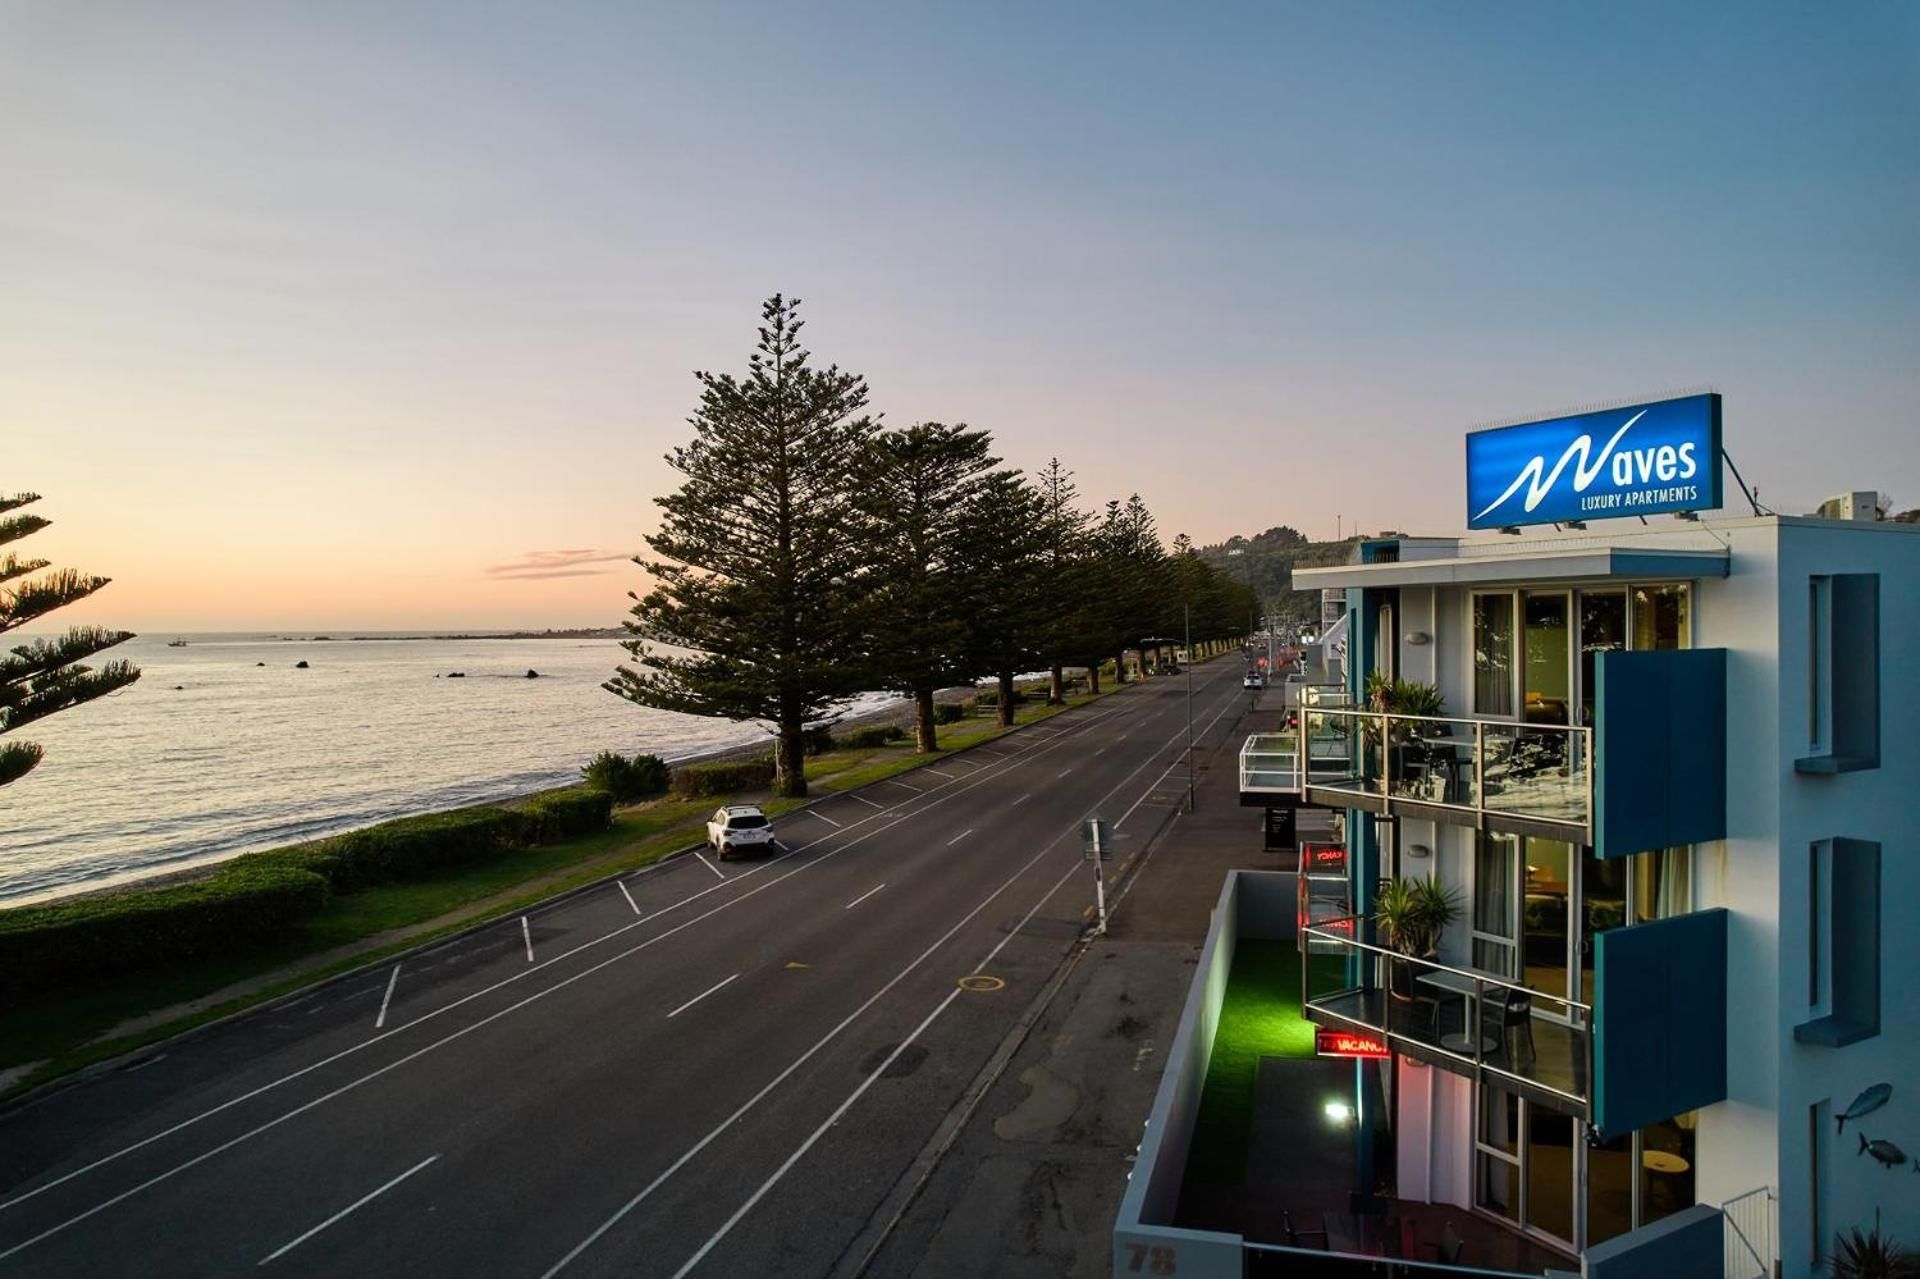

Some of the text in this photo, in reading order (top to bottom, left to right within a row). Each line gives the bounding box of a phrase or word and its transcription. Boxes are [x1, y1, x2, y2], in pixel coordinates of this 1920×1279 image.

[1581, 486, 1697, 511] LUXURY APARTMENTS
[1337, 1039, 1387, 1054] VACAN
[1125, 1242, 1176, 1275] 78
